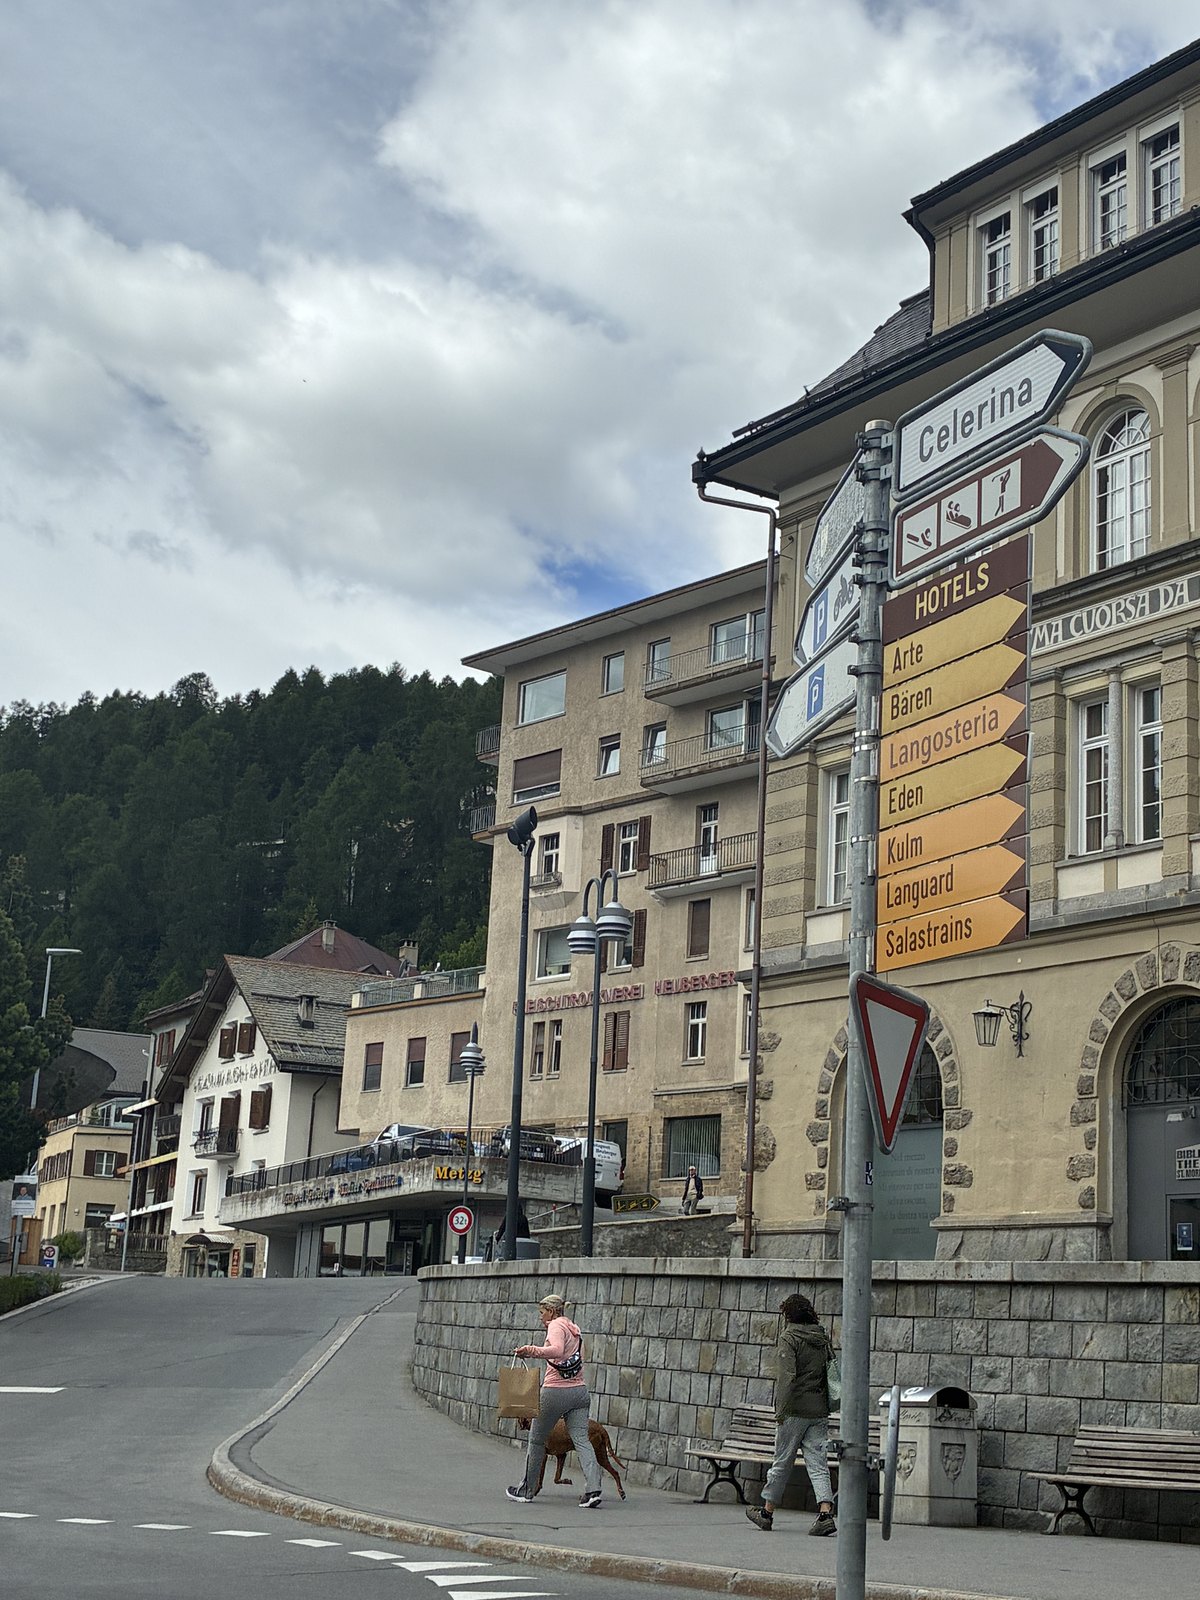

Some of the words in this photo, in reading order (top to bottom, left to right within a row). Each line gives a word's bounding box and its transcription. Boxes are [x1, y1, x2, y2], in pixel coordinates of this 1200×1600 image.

[919, 377, 1033, 463] Celerina
[915, 563, 990, 621] HOTELS
[1030, 619, 1063, 651] MA
[1070, 591, 1150, 637] CUORSA
[1159, 579, 1190, 611] DA
[892, 641, 924, 673] Arte
[891, 684, 932, 721] Bären
[889, 706, 1000, 769] Langosteria
[889, 784, 924, 814] Eden
[887, 833, 923, 865] Kulm
[886, 864, 955, 909] Languard
[886, 916, 973, 958] Salastrains
[655, 970, 737, 996] HEUBERGER
[435, 1166, 484, 1184] Metzg
